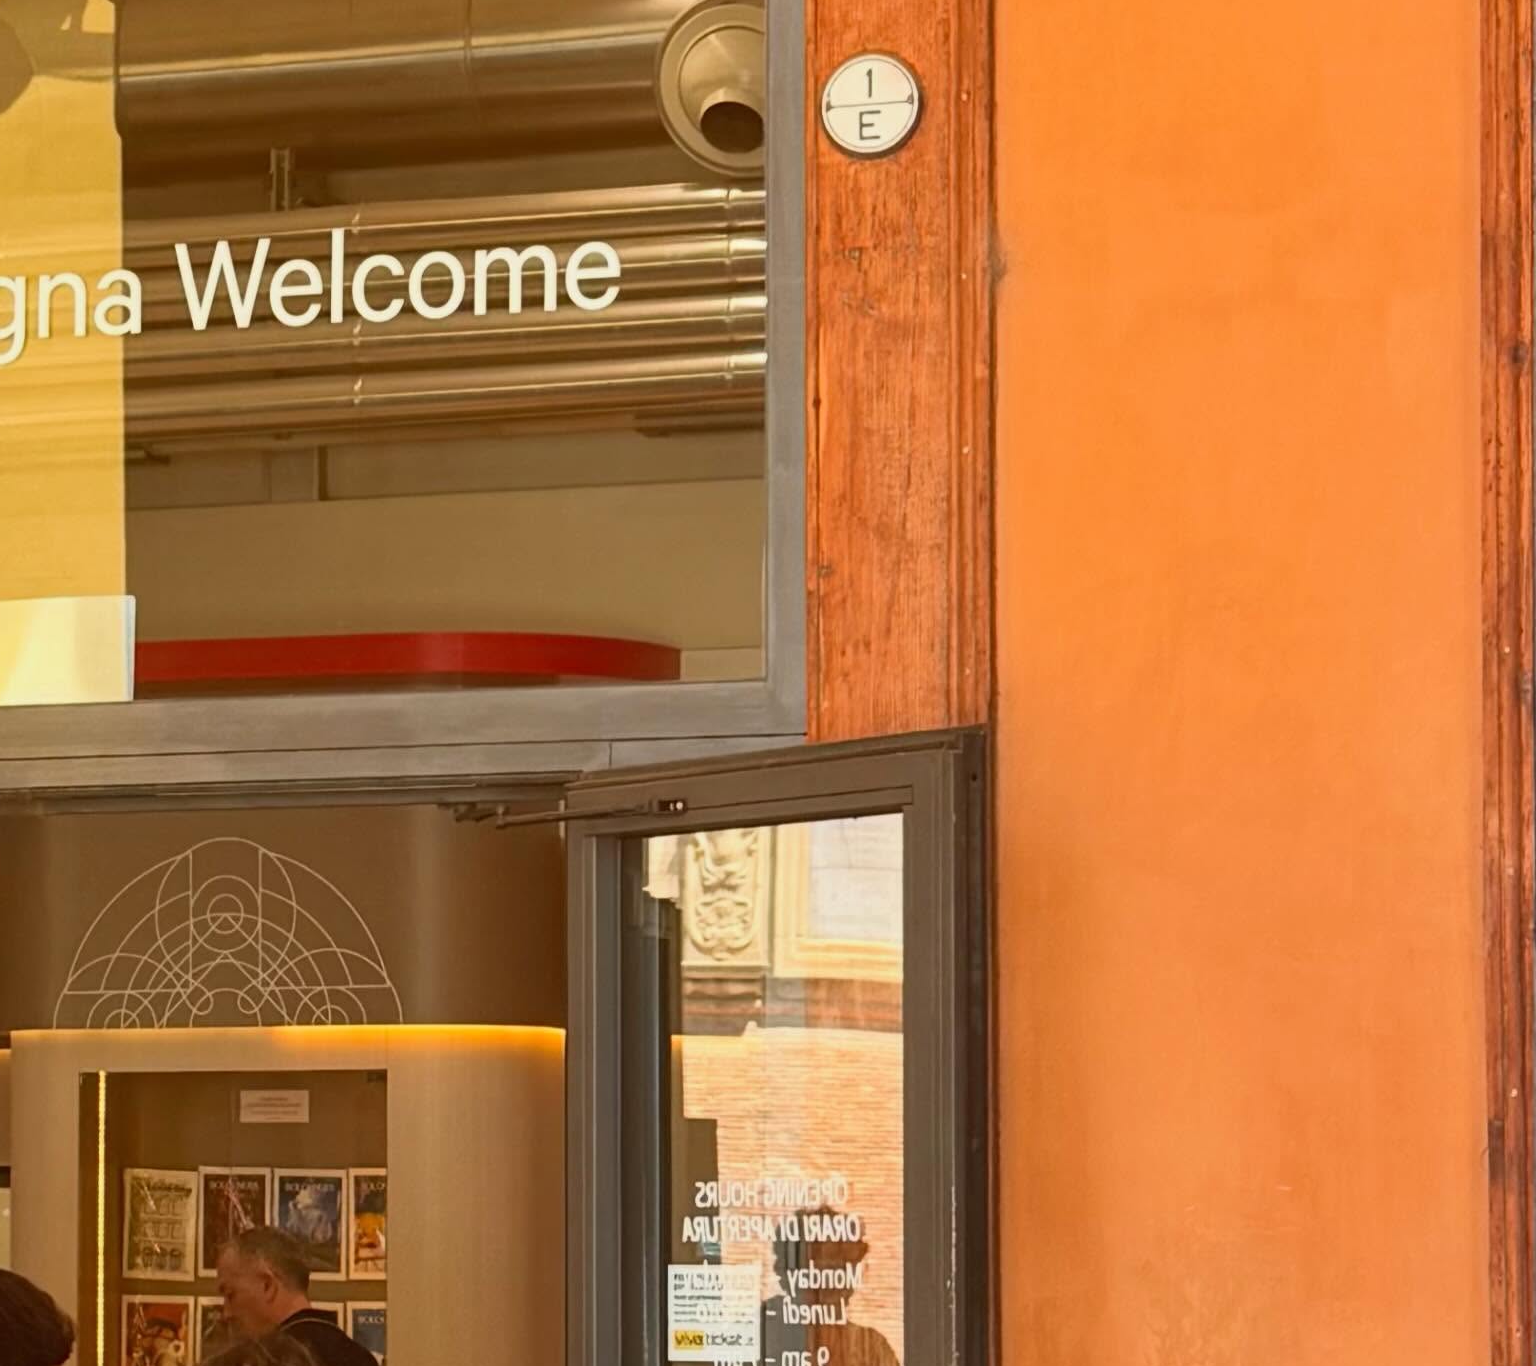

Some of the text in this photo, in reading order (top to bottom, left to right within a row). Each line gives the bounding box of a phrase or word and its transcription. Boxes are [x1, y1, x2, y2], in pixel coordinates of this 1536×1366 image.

[866, 68, 872, 98] 1
[859, 110, 881, 140] E
[175, 228, 622, 330] Welcome
